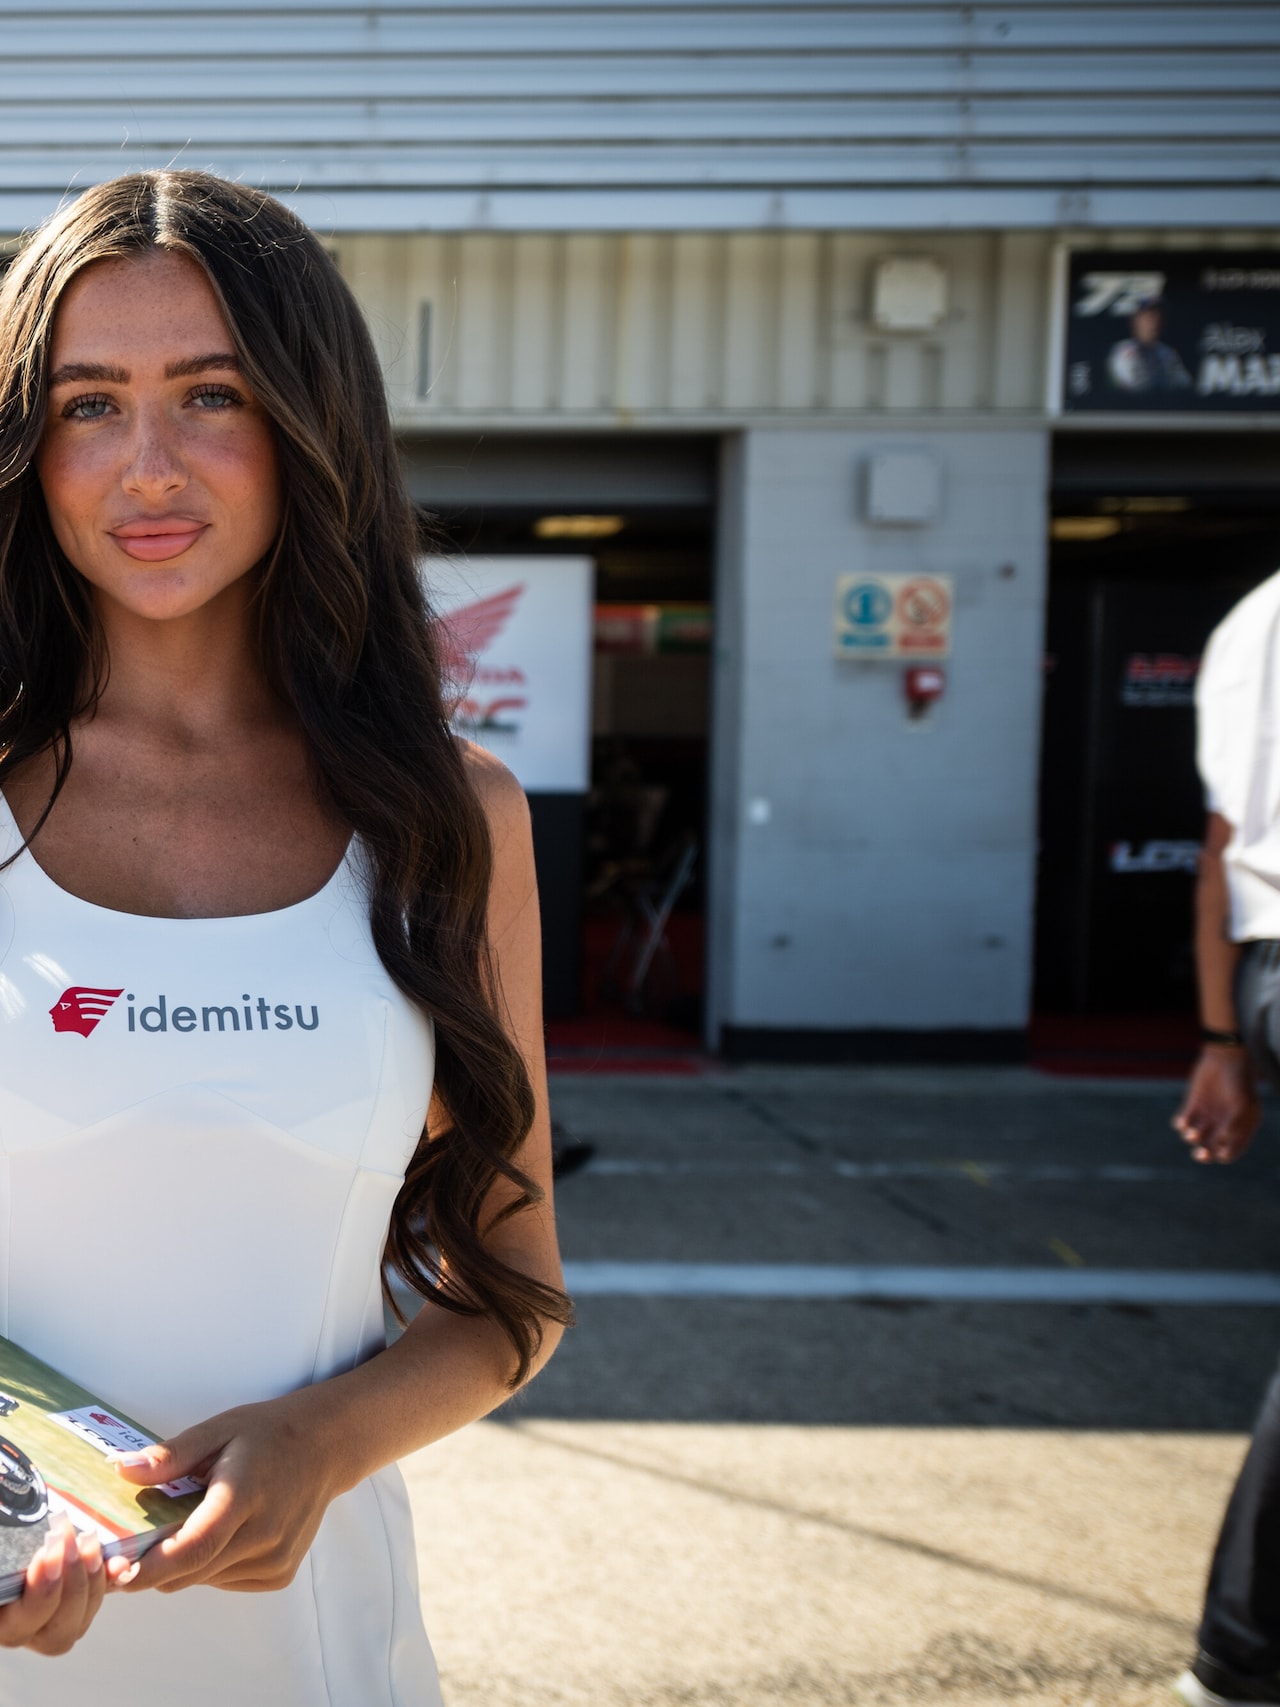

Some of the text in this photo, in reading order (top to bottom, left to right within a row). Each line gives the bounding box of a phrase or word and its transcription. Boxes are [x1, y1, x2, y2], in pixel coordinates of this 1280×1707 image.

[126, 993, 320, 1032] idemitsu
[69, 1416, 118, 1448] LCR
[118, 1430, 149, 1449] ide
